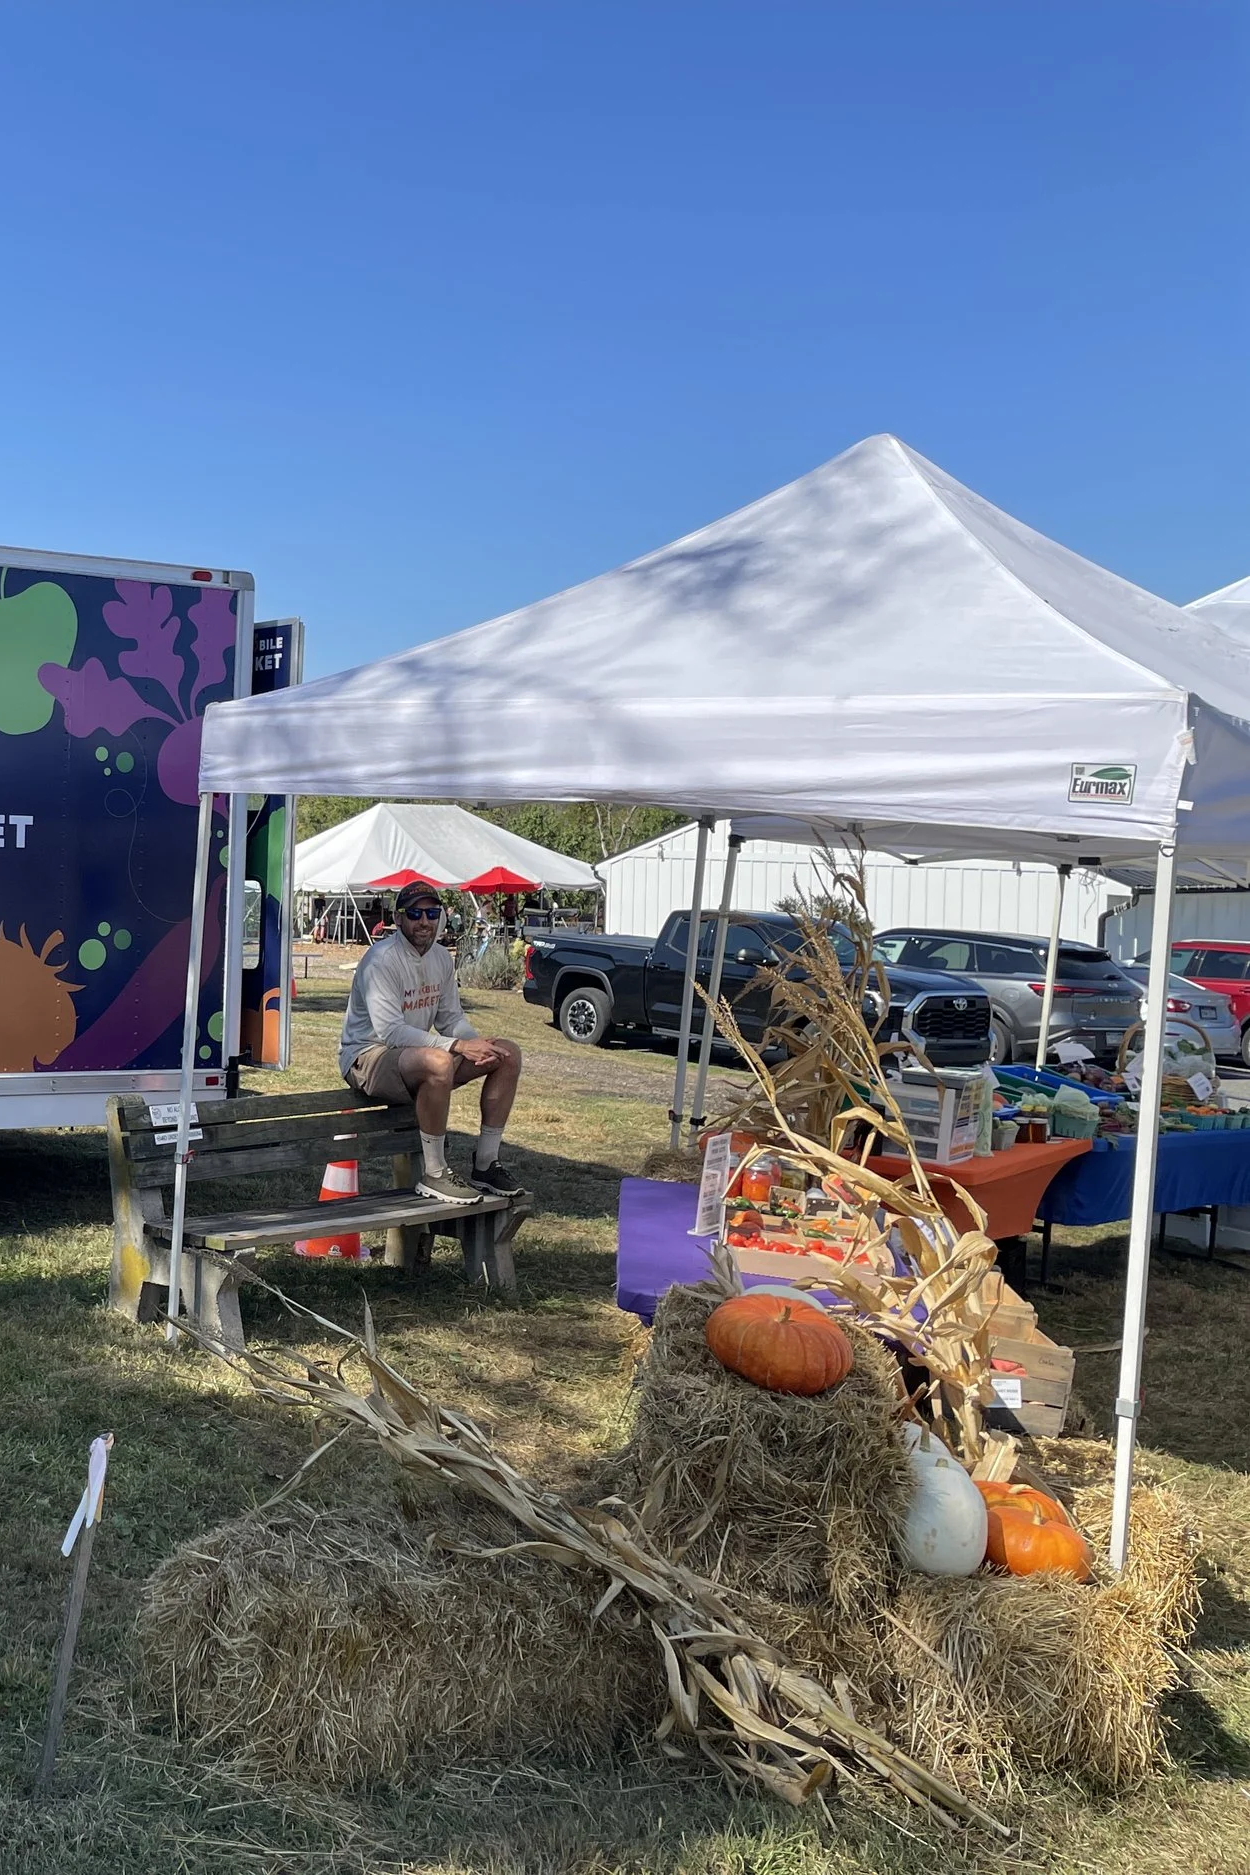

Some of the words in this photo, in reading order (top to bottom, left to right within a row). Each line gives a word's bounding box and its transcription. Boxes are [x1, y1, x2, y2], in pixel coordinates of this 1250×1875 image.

[1072, 777, 1127, 795] Eurmax
[404, 989, 415, 998] MY
[403, 995, 440, 1011] MARKET
